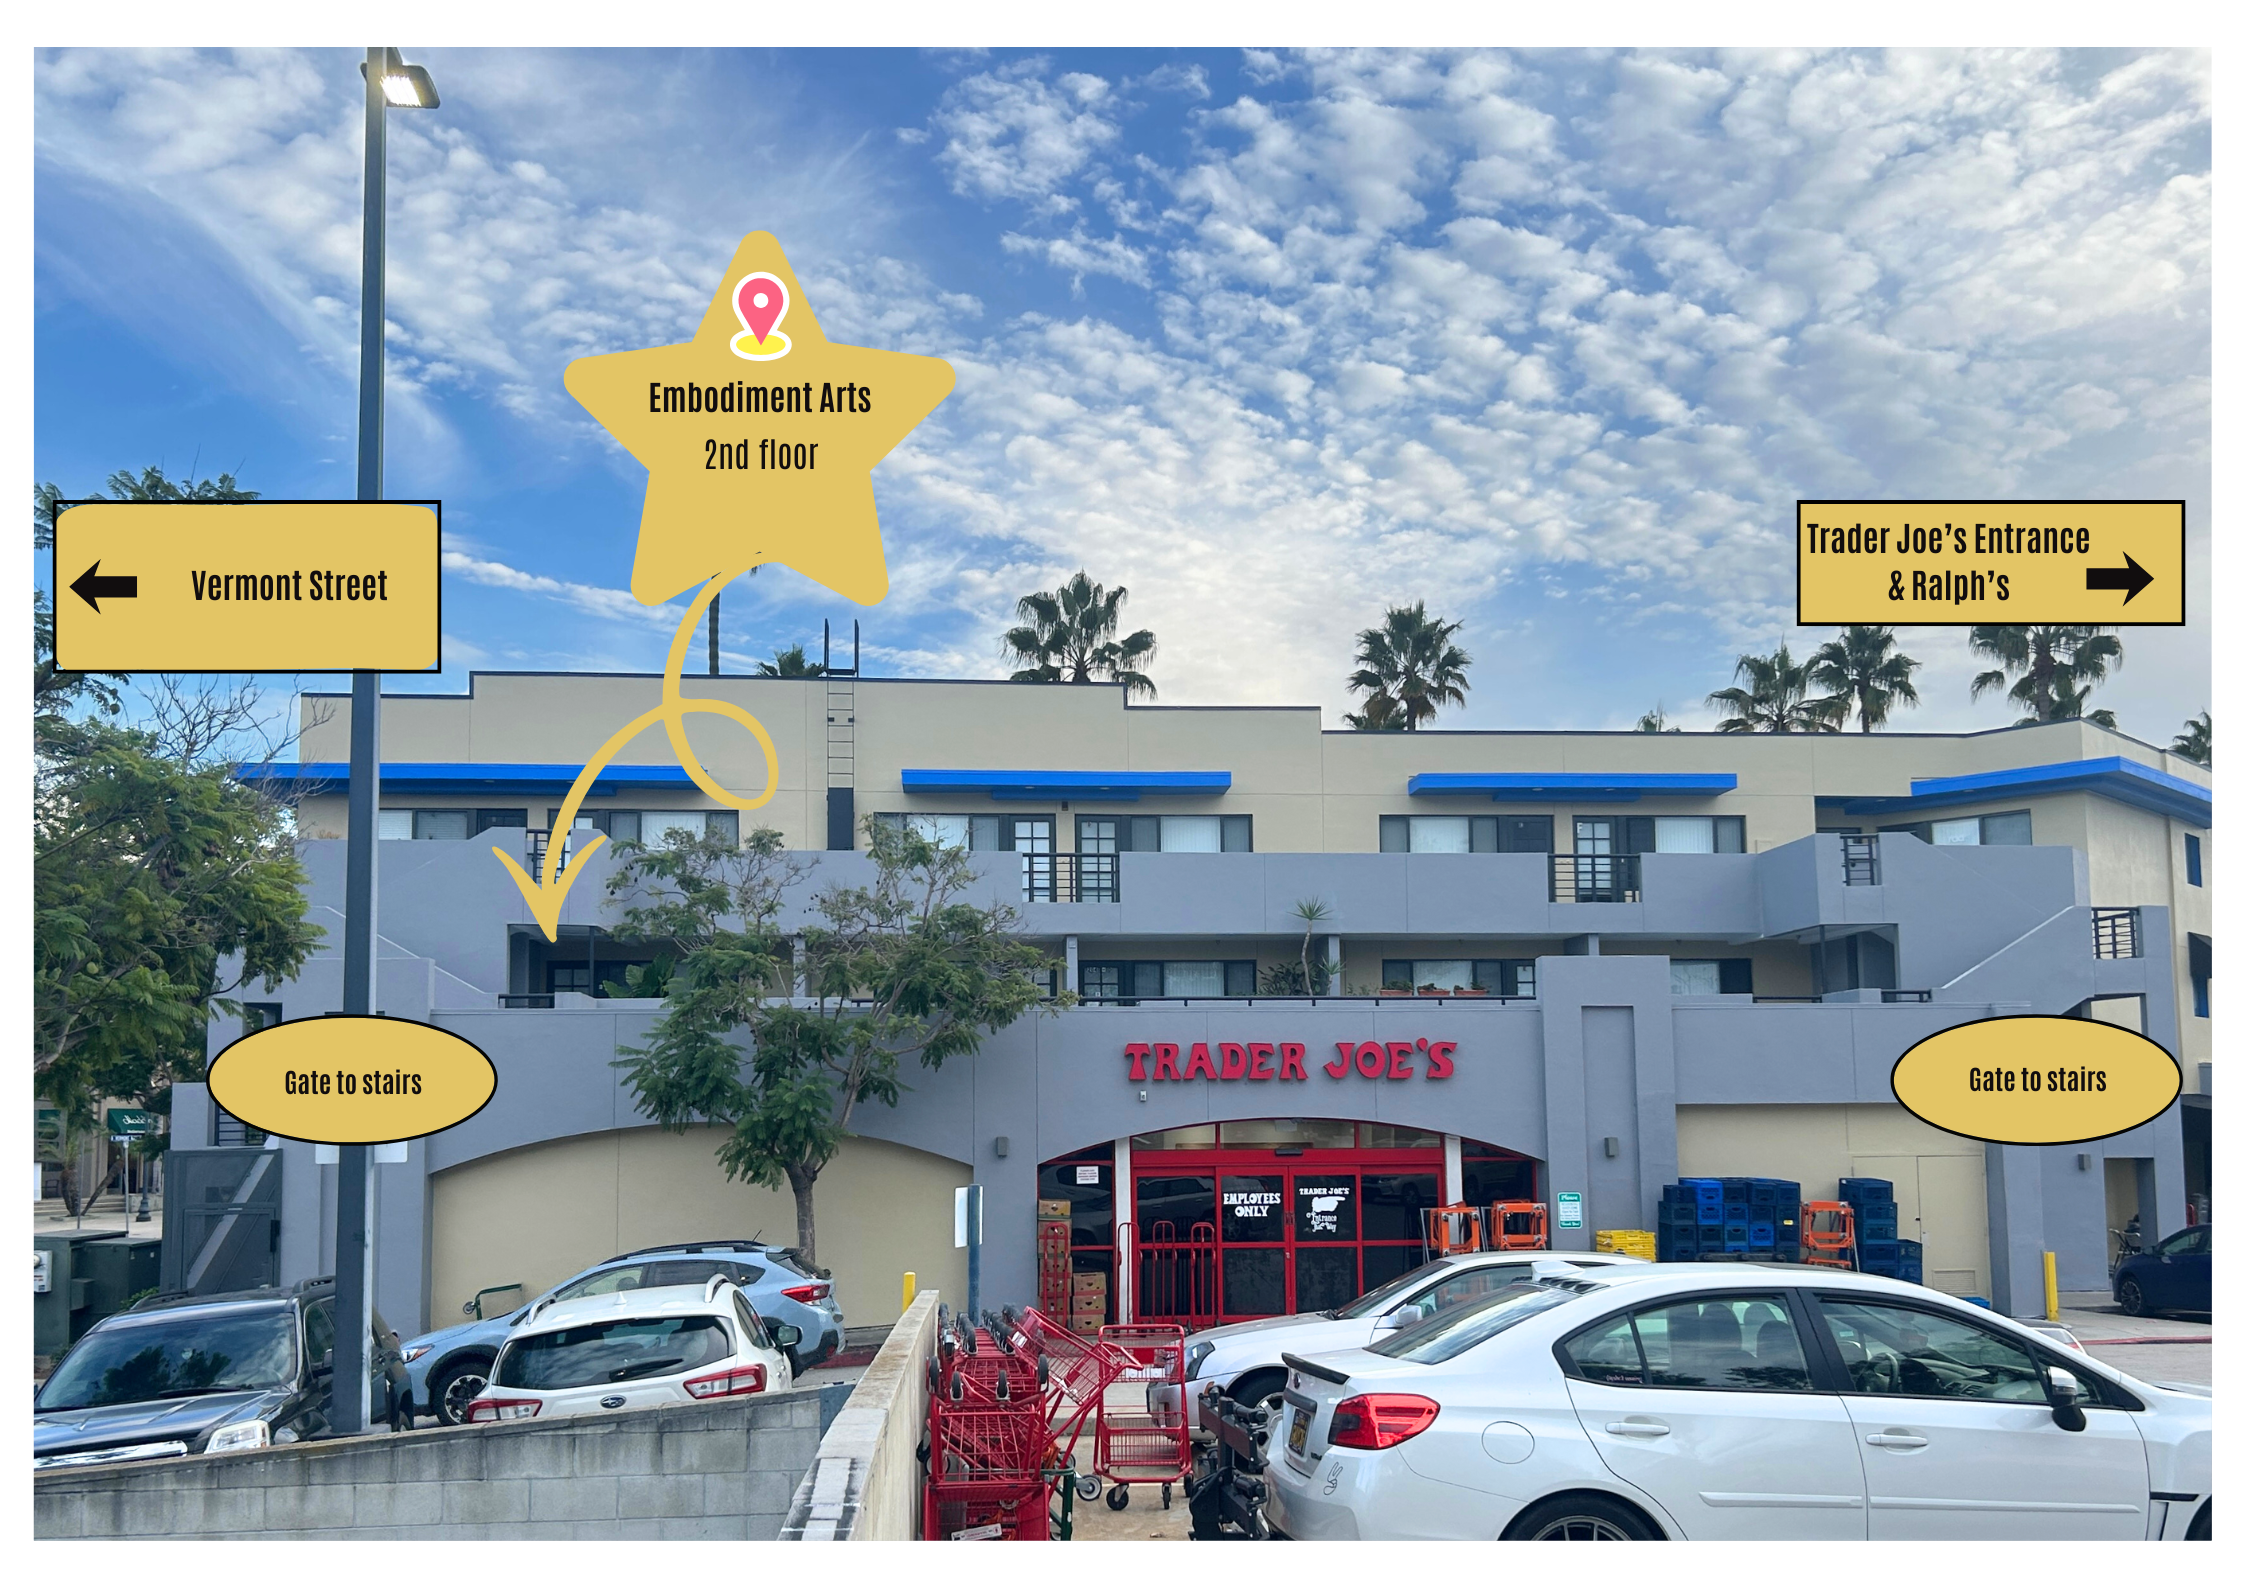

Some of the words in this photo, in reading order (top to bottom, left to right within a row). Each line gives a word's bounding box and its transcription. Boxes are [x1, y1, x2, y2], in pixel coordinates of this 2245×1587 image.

[1125, 1043, 1307, 1079] TRADER
[1324, 1037, 1457, 1078] JOE'S
[1299, 1187, 1327, 1195] TRADER
[1328, 1187, 1350, 1195] JOE'S
[1223, 1193, 1281, 1205] EMPLOYEES
[1234, 1205, 1270, 1217] ONLY
